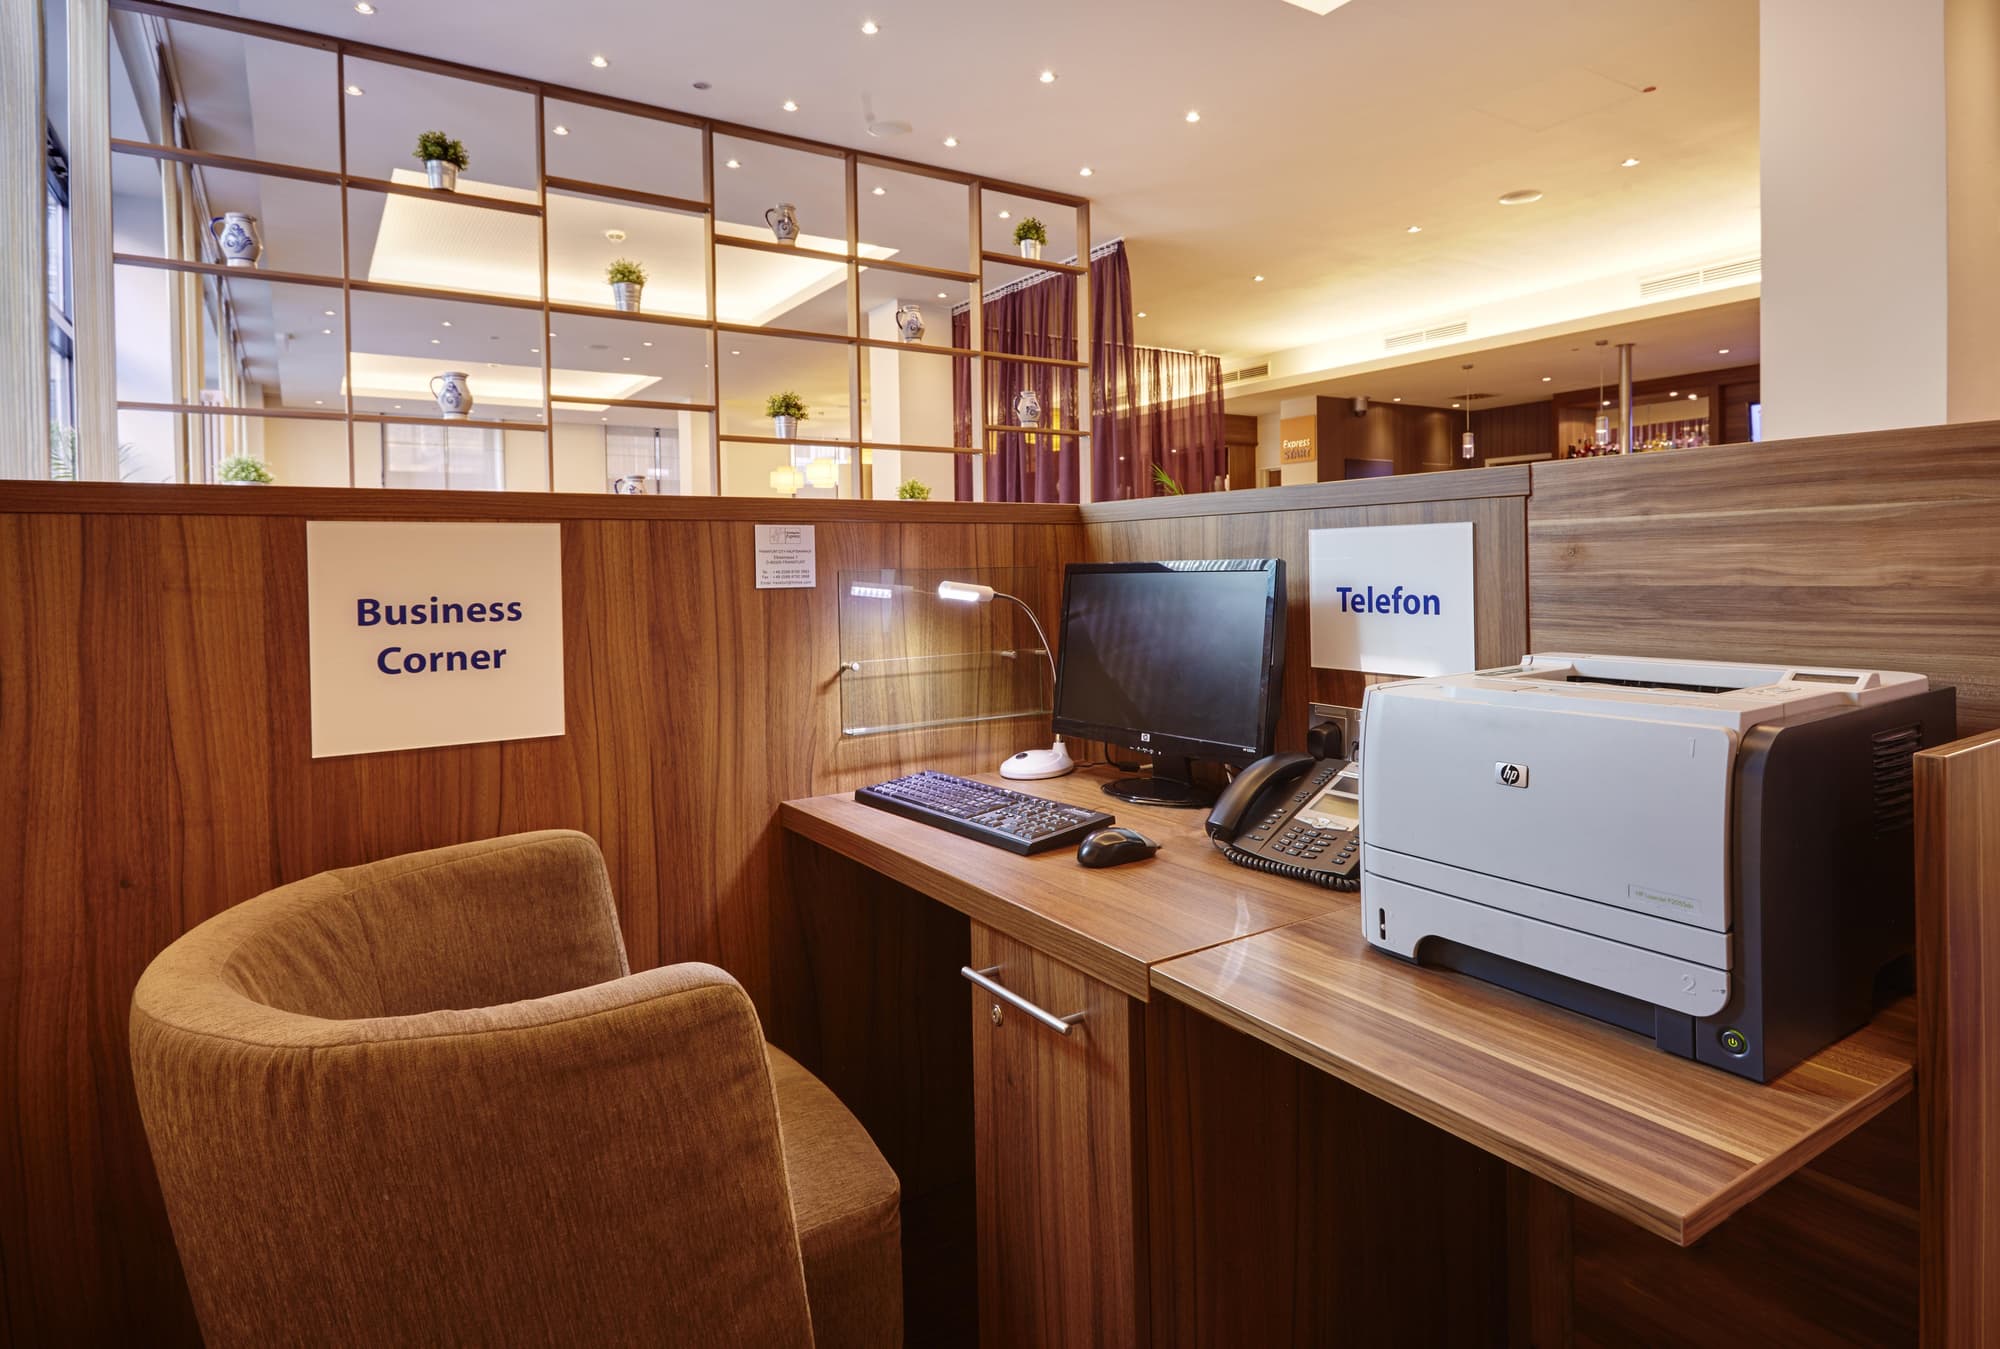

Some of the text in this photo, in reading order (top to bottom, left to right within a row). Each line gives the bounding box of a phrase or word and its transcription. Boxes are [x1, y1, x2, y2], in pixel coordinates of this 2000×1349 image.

[1283, 438, 1310, 449] Express
[357, 596, 523, 627] Business
[1336, 586, 1441, 616] Telefon
[377, 646, 507, 675] Corner
[1503, 764, 1518, 785] hp
[1681, 974, 1697, 996] 2
